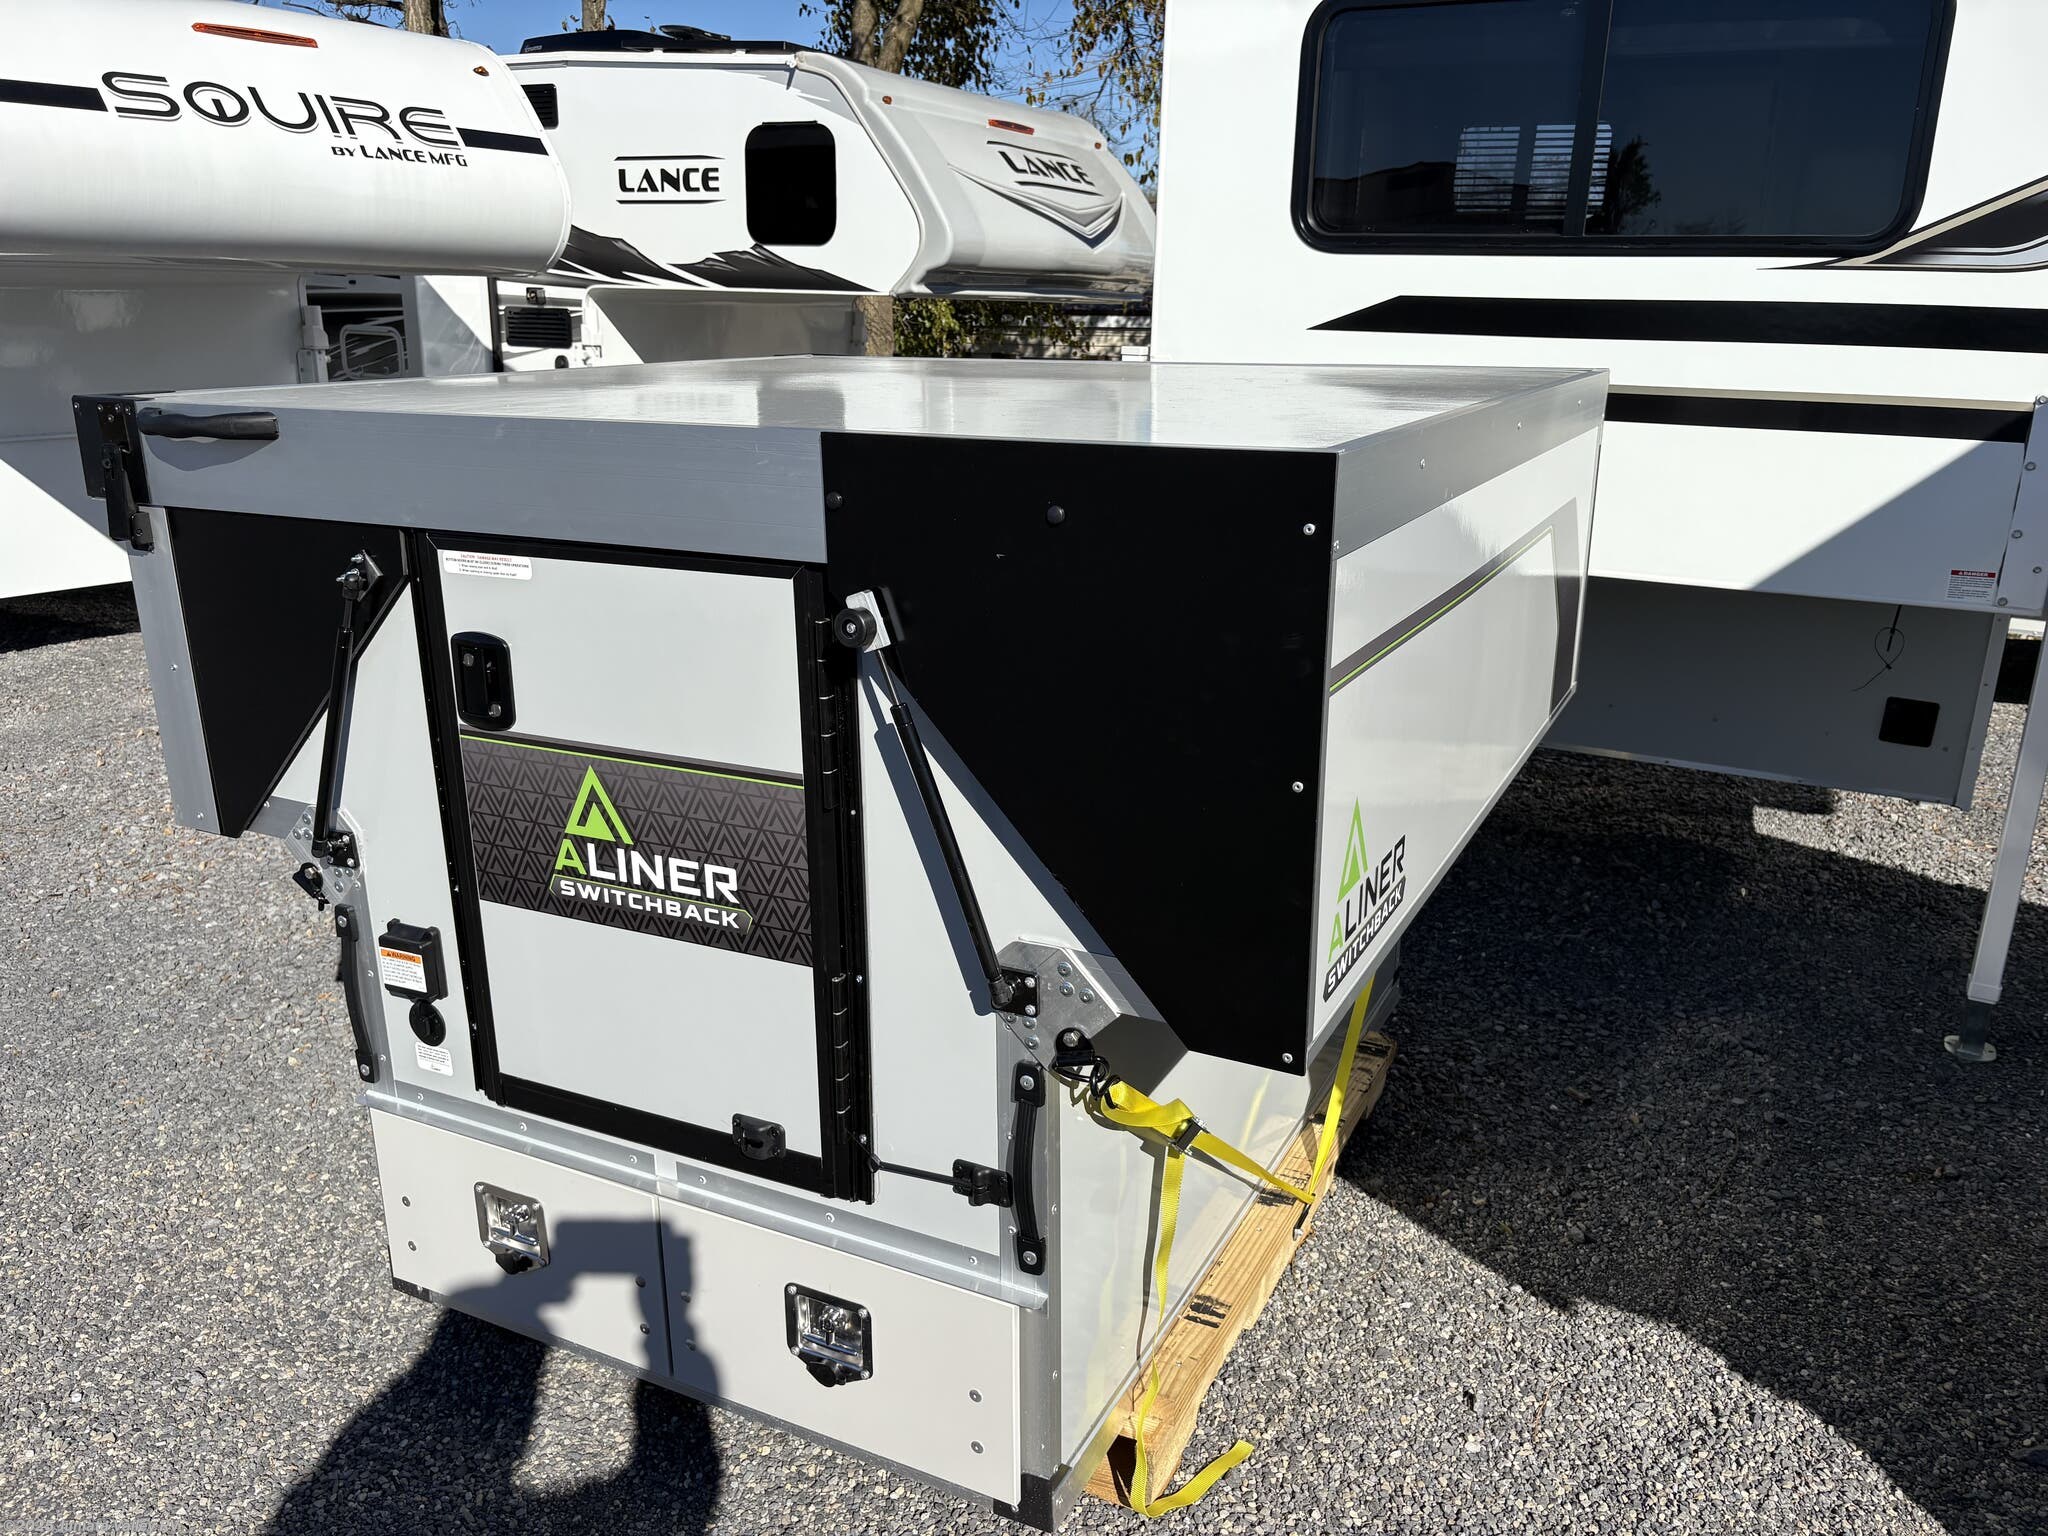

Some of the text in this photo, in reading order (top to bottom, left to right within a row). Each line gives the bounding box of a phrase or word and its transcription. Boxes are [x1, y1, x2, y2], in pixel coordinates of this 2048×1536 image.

[101, 71, 462, 149] SQUIRE
[331, 145, 468, 167] BY LANCE MFG
[618, 167, 720, 193] LANCE
[998, 150, 1094, 186] LANCE
[554, 839, 740, 904] ALINER
[1328, 834, 1406, 964] ALINER
[560, 879, 740, 929] SWITCHBACK
[1327, 889, 1403, 991] SWITCHBACK
